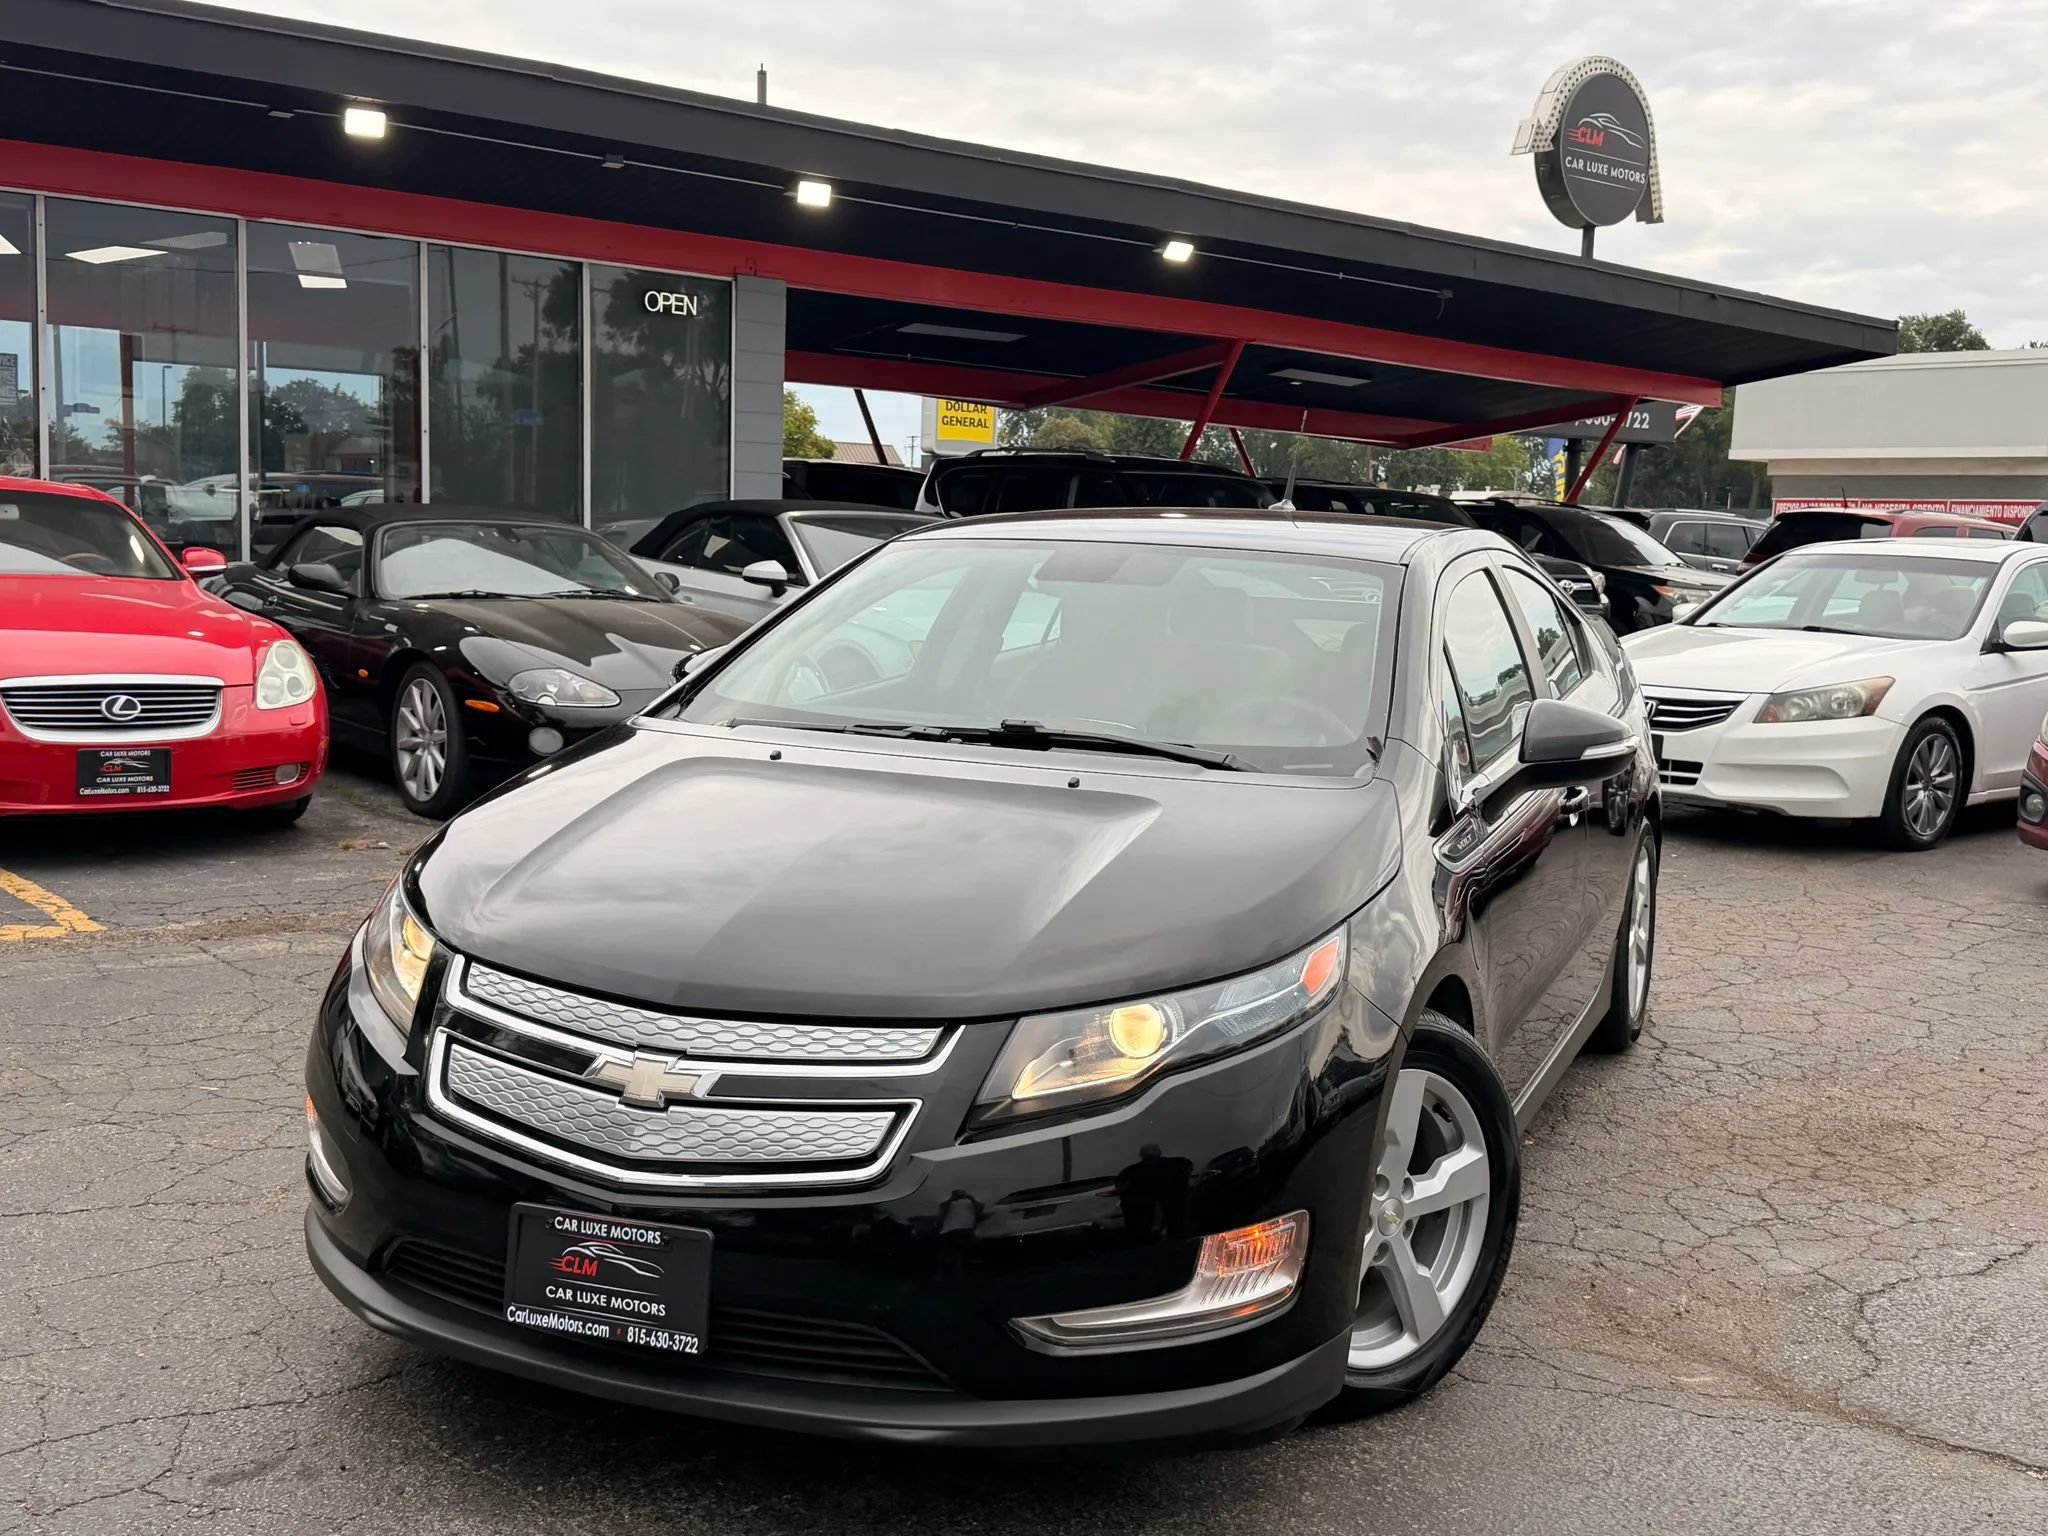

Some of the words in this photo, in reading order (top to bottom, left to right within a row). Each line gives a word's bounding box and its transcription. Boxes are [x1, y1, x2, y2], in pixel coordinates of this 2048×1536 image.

[1576, 127, 1605, 146] CLM
[1565, 156, 1583, 170] CAR
[1586, 160, 1608, 176] LUXE
[1610, 166, 1646, 184] MOTORS
[644, 290, 698, 316] OPEN
[945, 401, 988, 414] DOLLAR
[941, 415, 990, 429] GENERAL
[1456, 833, 1472, 850] VOLT
[554, 1216, 578, 1232] CAR
[581, 1220, 608, 1237] LUXE
[610, 1226, 661, 1245] MOTORS
[561, 1255, 599, 1277] CLM
[545, 1285, 573, 1301] CAR
[577, 1290, 607, 1306] LUXE
[610, 1298, 666, 1317] MOTORS
[507, 1305, 609, 1338] CarLuxeMotors.com
[627, 1326, 699, 1354] 815-630-3722
